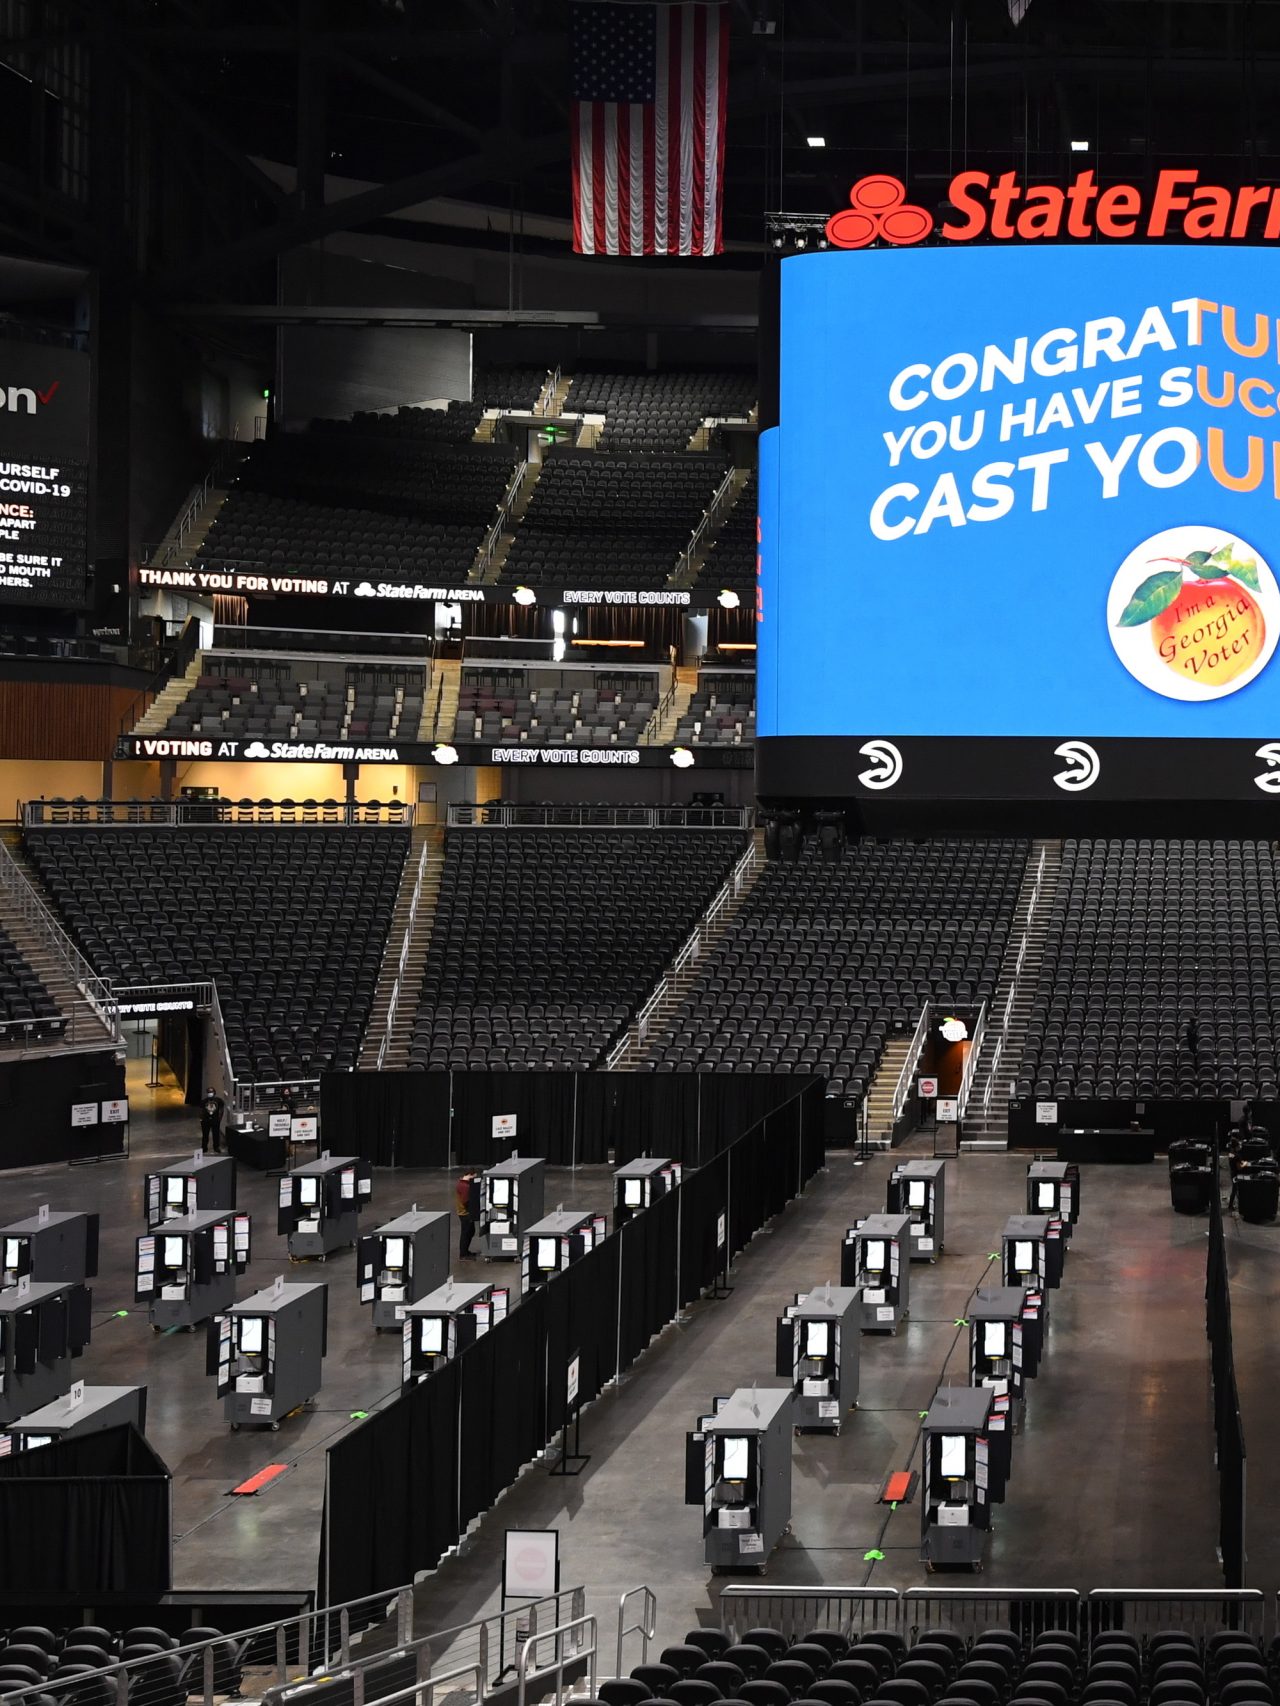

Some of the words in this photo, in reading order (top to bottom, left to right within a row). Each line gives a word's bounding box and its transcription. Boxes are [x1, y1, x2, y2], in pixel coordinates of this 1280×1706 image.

[883, 410, 984, 466] YOU
[1000, 369, 1142, 446] HAVE
[0, 478, 71, 498] COVID-19
[870, 445, 1068, 540] CAST
[9, 565, 51, 577] MOUTH
[17, 553, 49, 566] SURE
[51, 556, 63, 567] IT
[140, 570, 196, 586] THANK
[199, 574, 232, 588] YOU
[237, 576, 268, 590] FOR
[271, 578, 327, 593] VOTING
[333, 582, 350, 594] AT
[448, 590, 484, 600] ARENA
[563, 590, 604, 603] EVERY
[605, 591, 637, 604] VOTE
[638, 592, 691, 605] COUNTS
[1176, 603, 1200, 623] I'm
[1206, 595, 1215, 608] a
[1158, 597, 1250, 664] Georgia
[1183, 628, 1250, 675] Voter
[144, 741, 212, 756] VOTING
[218, 742, 238, 756] AT
[355, 748, 398, 760] ARENA
[492, 748, 539, 763] EVERY
[540, 749, 579, 763] VOTE
[580, 749, 640, 764] COUNTS
